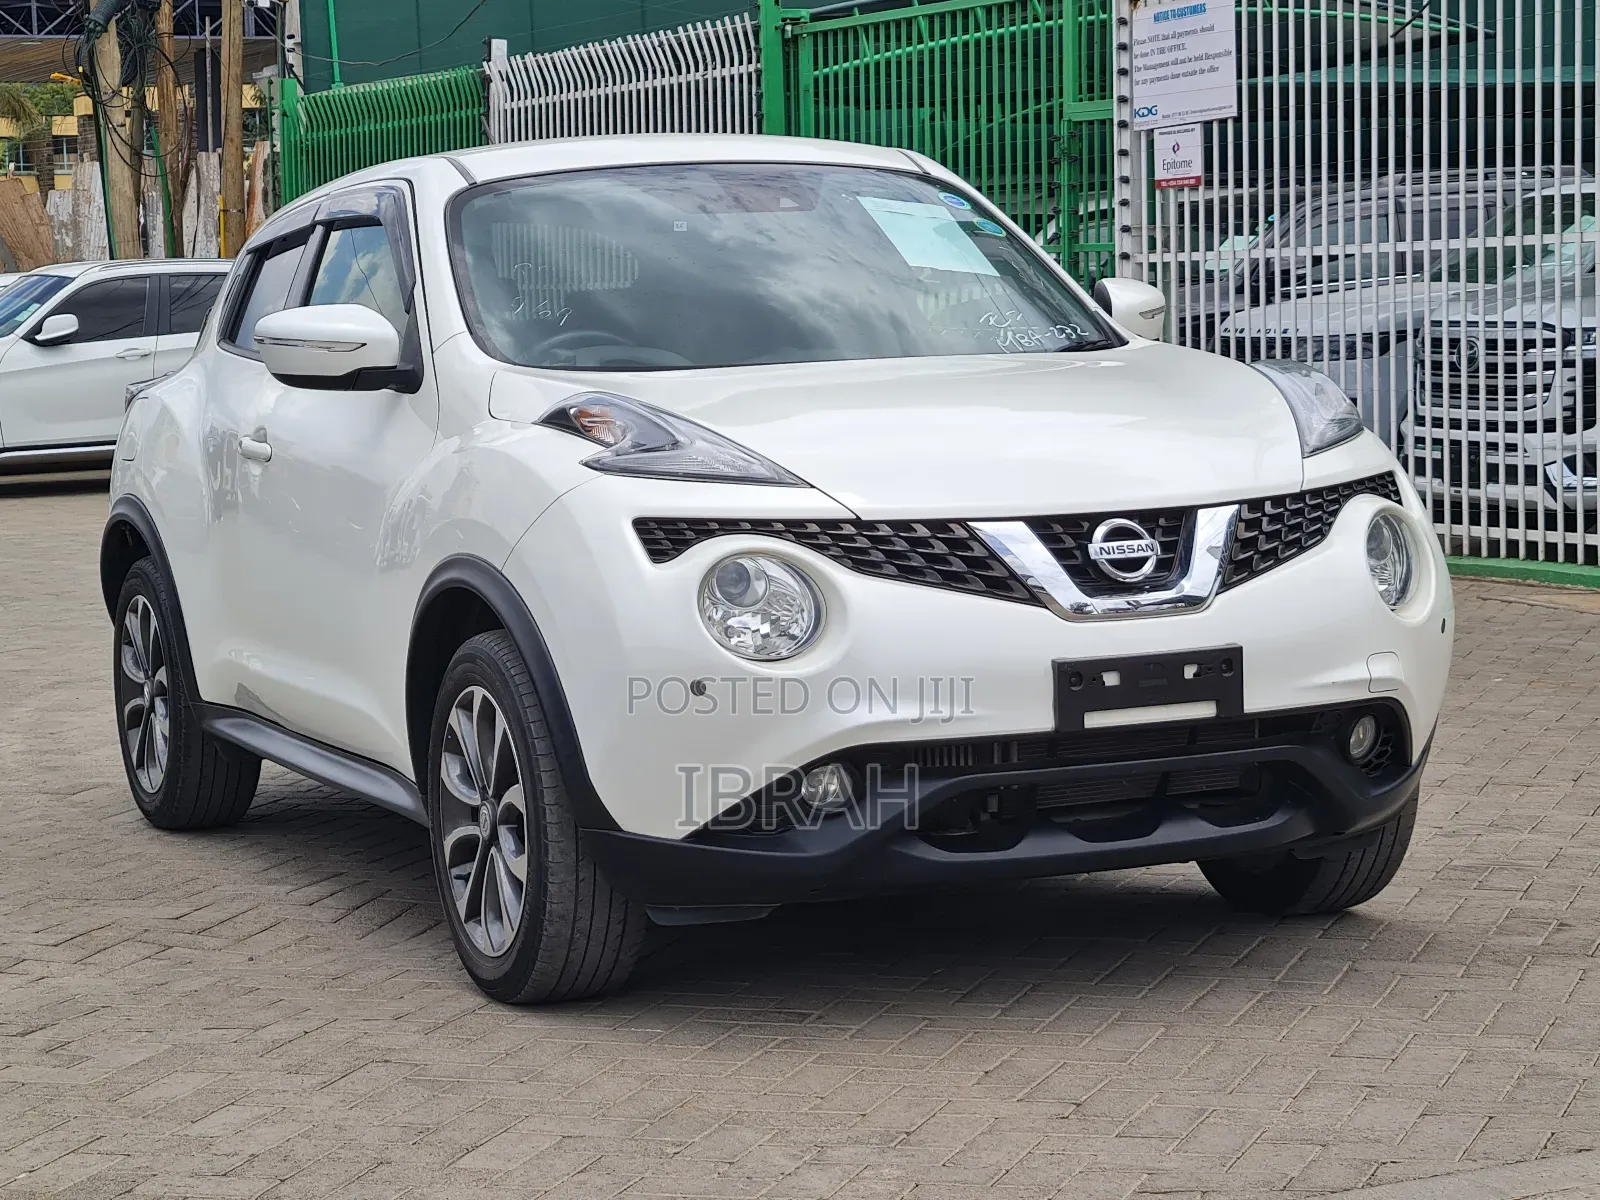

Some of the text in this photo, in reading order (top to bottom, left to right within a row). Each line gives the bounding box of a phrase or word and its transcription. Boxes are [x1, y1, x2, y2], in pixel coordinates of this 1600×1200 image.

[1153, 3, 1207, 22] NOTICE TO CUSTOMERS
[1134, 38, 1146, 46] Please
[1148, 34, 1160, 43] NOTE
[1161, 32, 1170, 41] that
[1177, 28, 1198, 39] payments
[1199, 24, 1215, 33] should
[1142, 61, 1170, 71] Management
[1194, 53, 1204, 62] held
[1204, 48, 1232, 60] Responsible
[1150, 48, 1156, 56] IN
[1156, 46, 1166, 56] THE
[1149, 74, 1170, 86] payments
[1170, 72, 1180, 80] done
[1182, 69, 1198, 78] outside
[1206, 64, 1220, 74] office
[1134, 105, 1158, 118] KDG
[1162, 158, 1192, 174] Epitome
[1099, 543, 1154, 556] NISSAN
